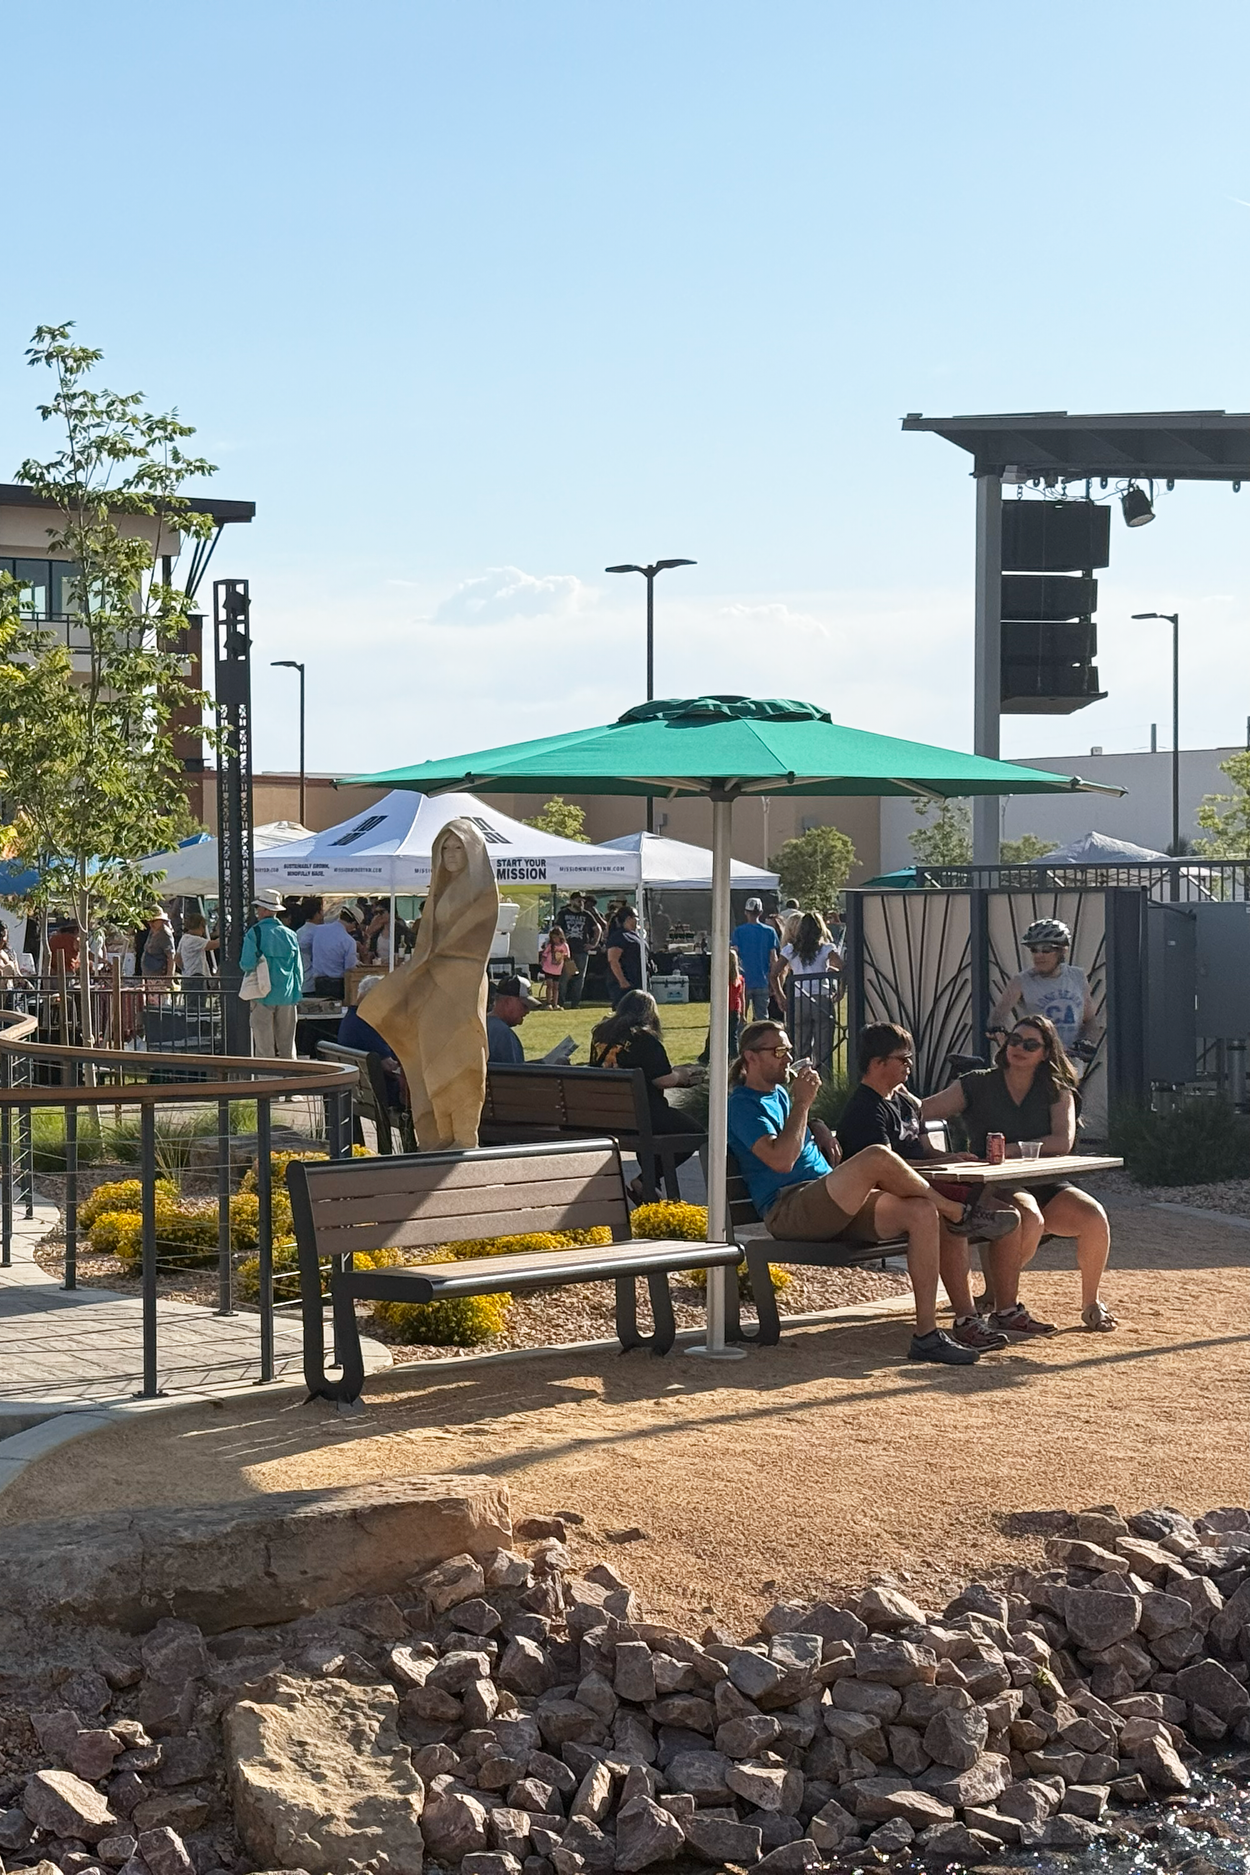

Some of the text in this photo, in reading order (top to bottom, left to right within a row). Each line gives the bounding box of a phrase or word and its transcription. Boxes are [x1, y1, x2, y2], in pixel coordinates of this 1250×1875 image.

[496, 859, 547, 867] START YOUR
[496, 868, 547, 880] MISSION
